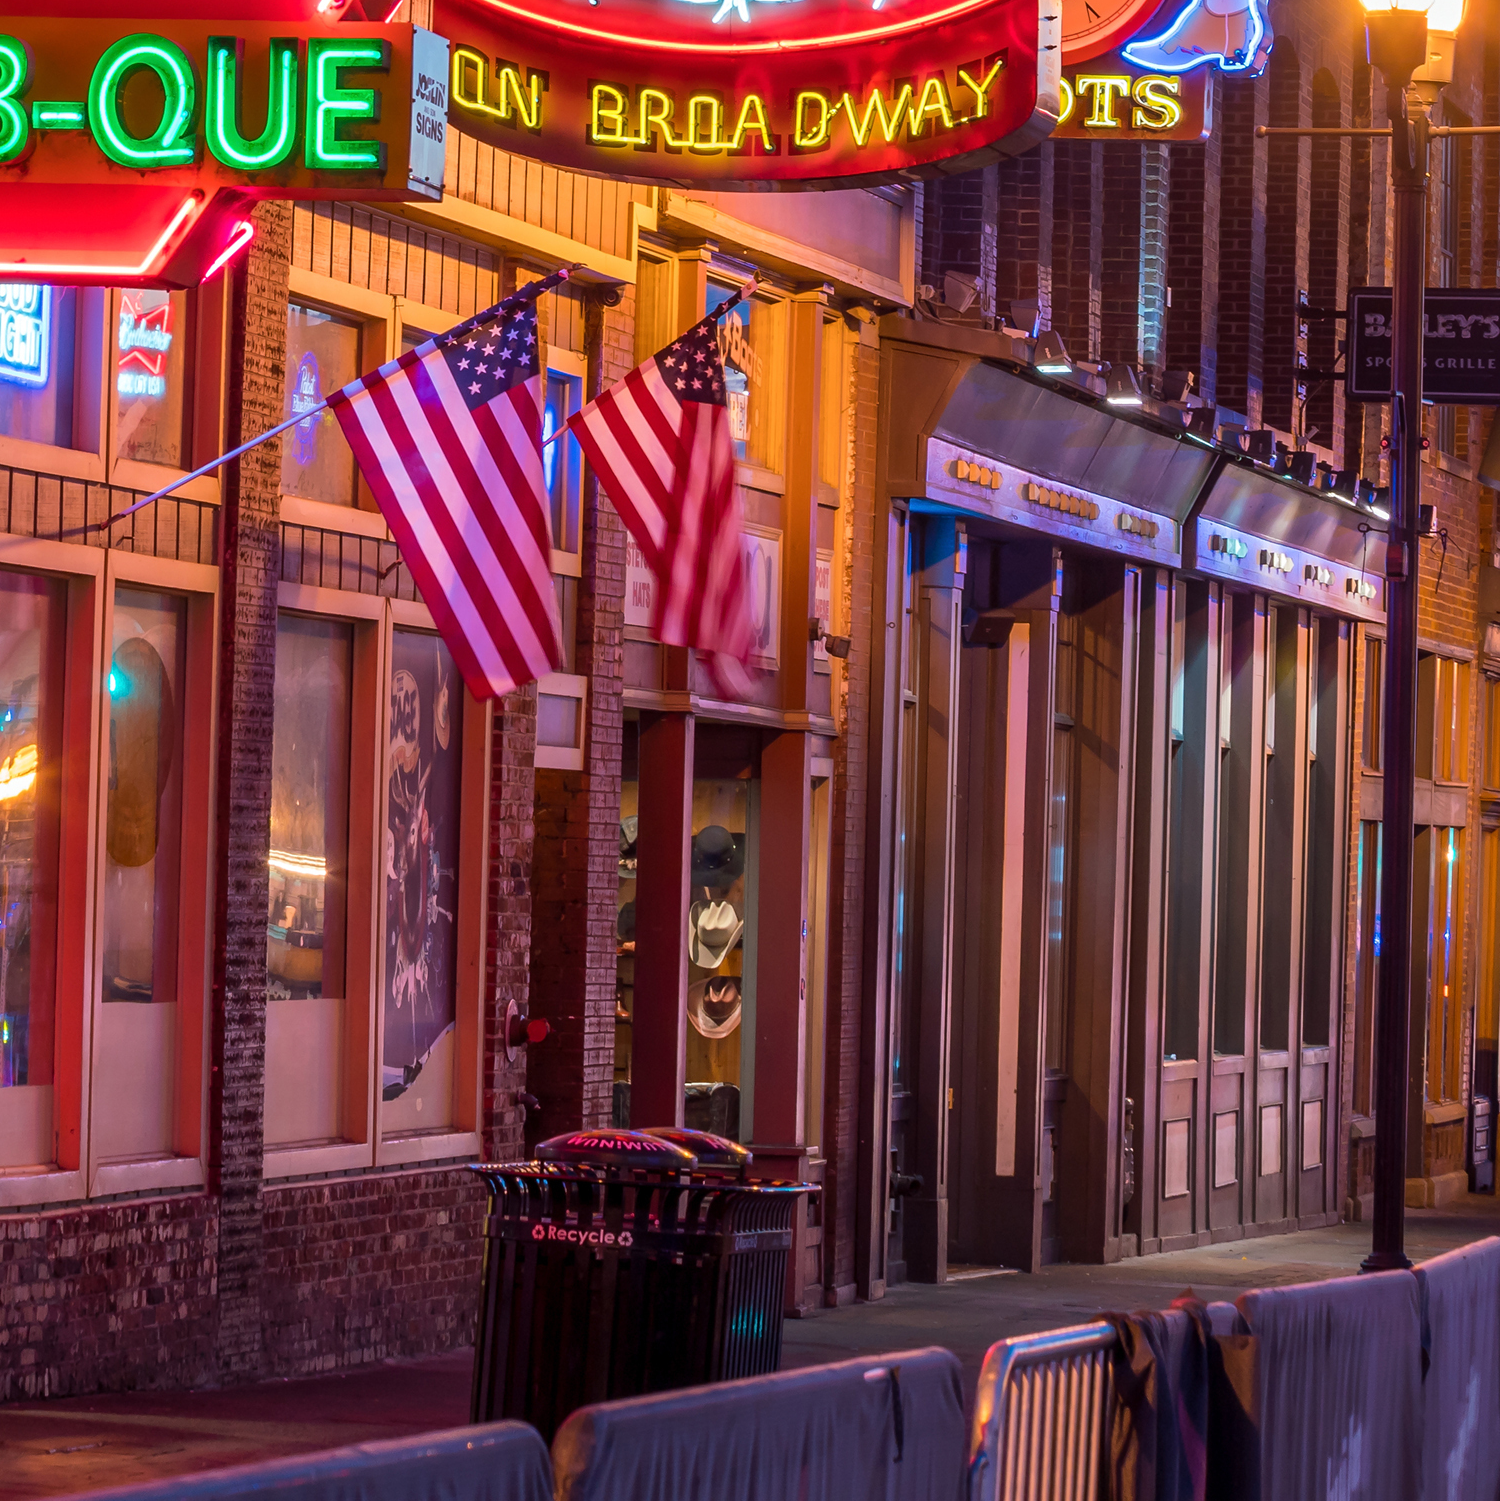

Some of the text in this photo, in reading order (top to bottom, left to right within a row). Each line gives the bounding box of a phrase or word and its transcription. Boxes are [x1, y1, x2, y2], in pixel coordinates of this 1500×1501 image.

[452, 48, 1003, 152] ON BROADWAY
[416, 112, 443, 144] SIGNS
[118, 312, 173, 352] Budweiser
[1435, 357, 1497, 370] GRILLE
[632, 581, 651, 609] HATS
[547, 1225, 615, 1246] Recycle
